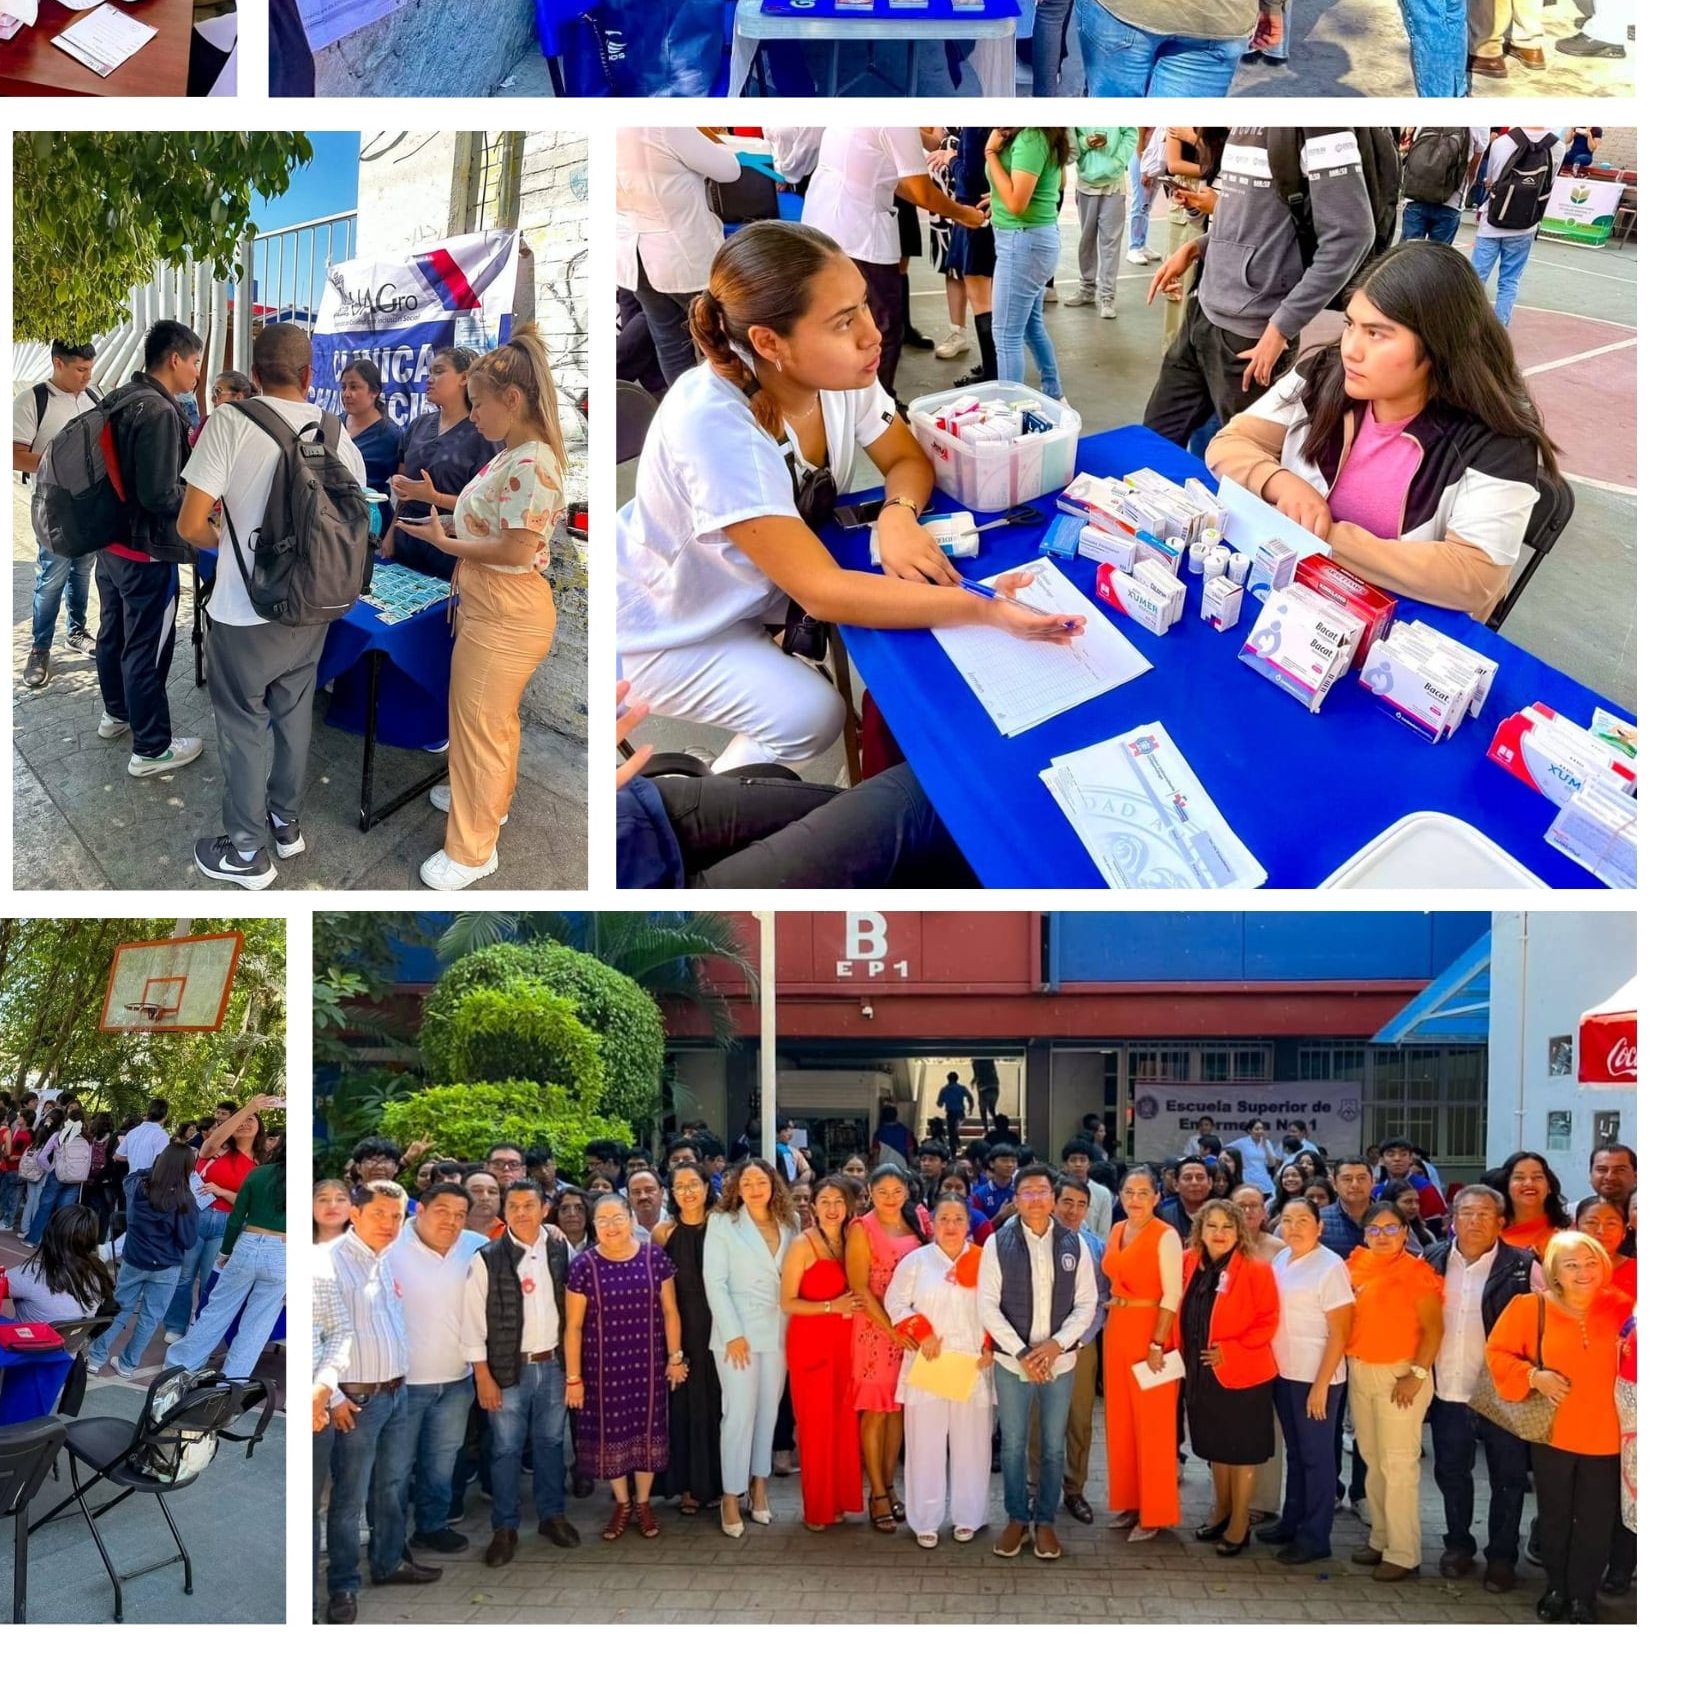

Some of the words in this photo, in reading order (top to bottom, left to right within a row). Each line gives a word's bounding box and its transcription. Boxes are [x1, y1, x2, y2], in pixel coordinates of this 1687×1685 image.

[1127, 590, 1159, 613] XUMER
[1315, 622, 1338, 642] Bacat
[1310, 639, 1334, 658] Bacat
[1423, 682, 1450, 702] Bacat
[846, 911, 887, 959] B
[1166, 1100, 1231, 1113] Escuela
[1237, 1100, 1308, 1116] Superior
[1312, 1101, 1331, 1113] de
